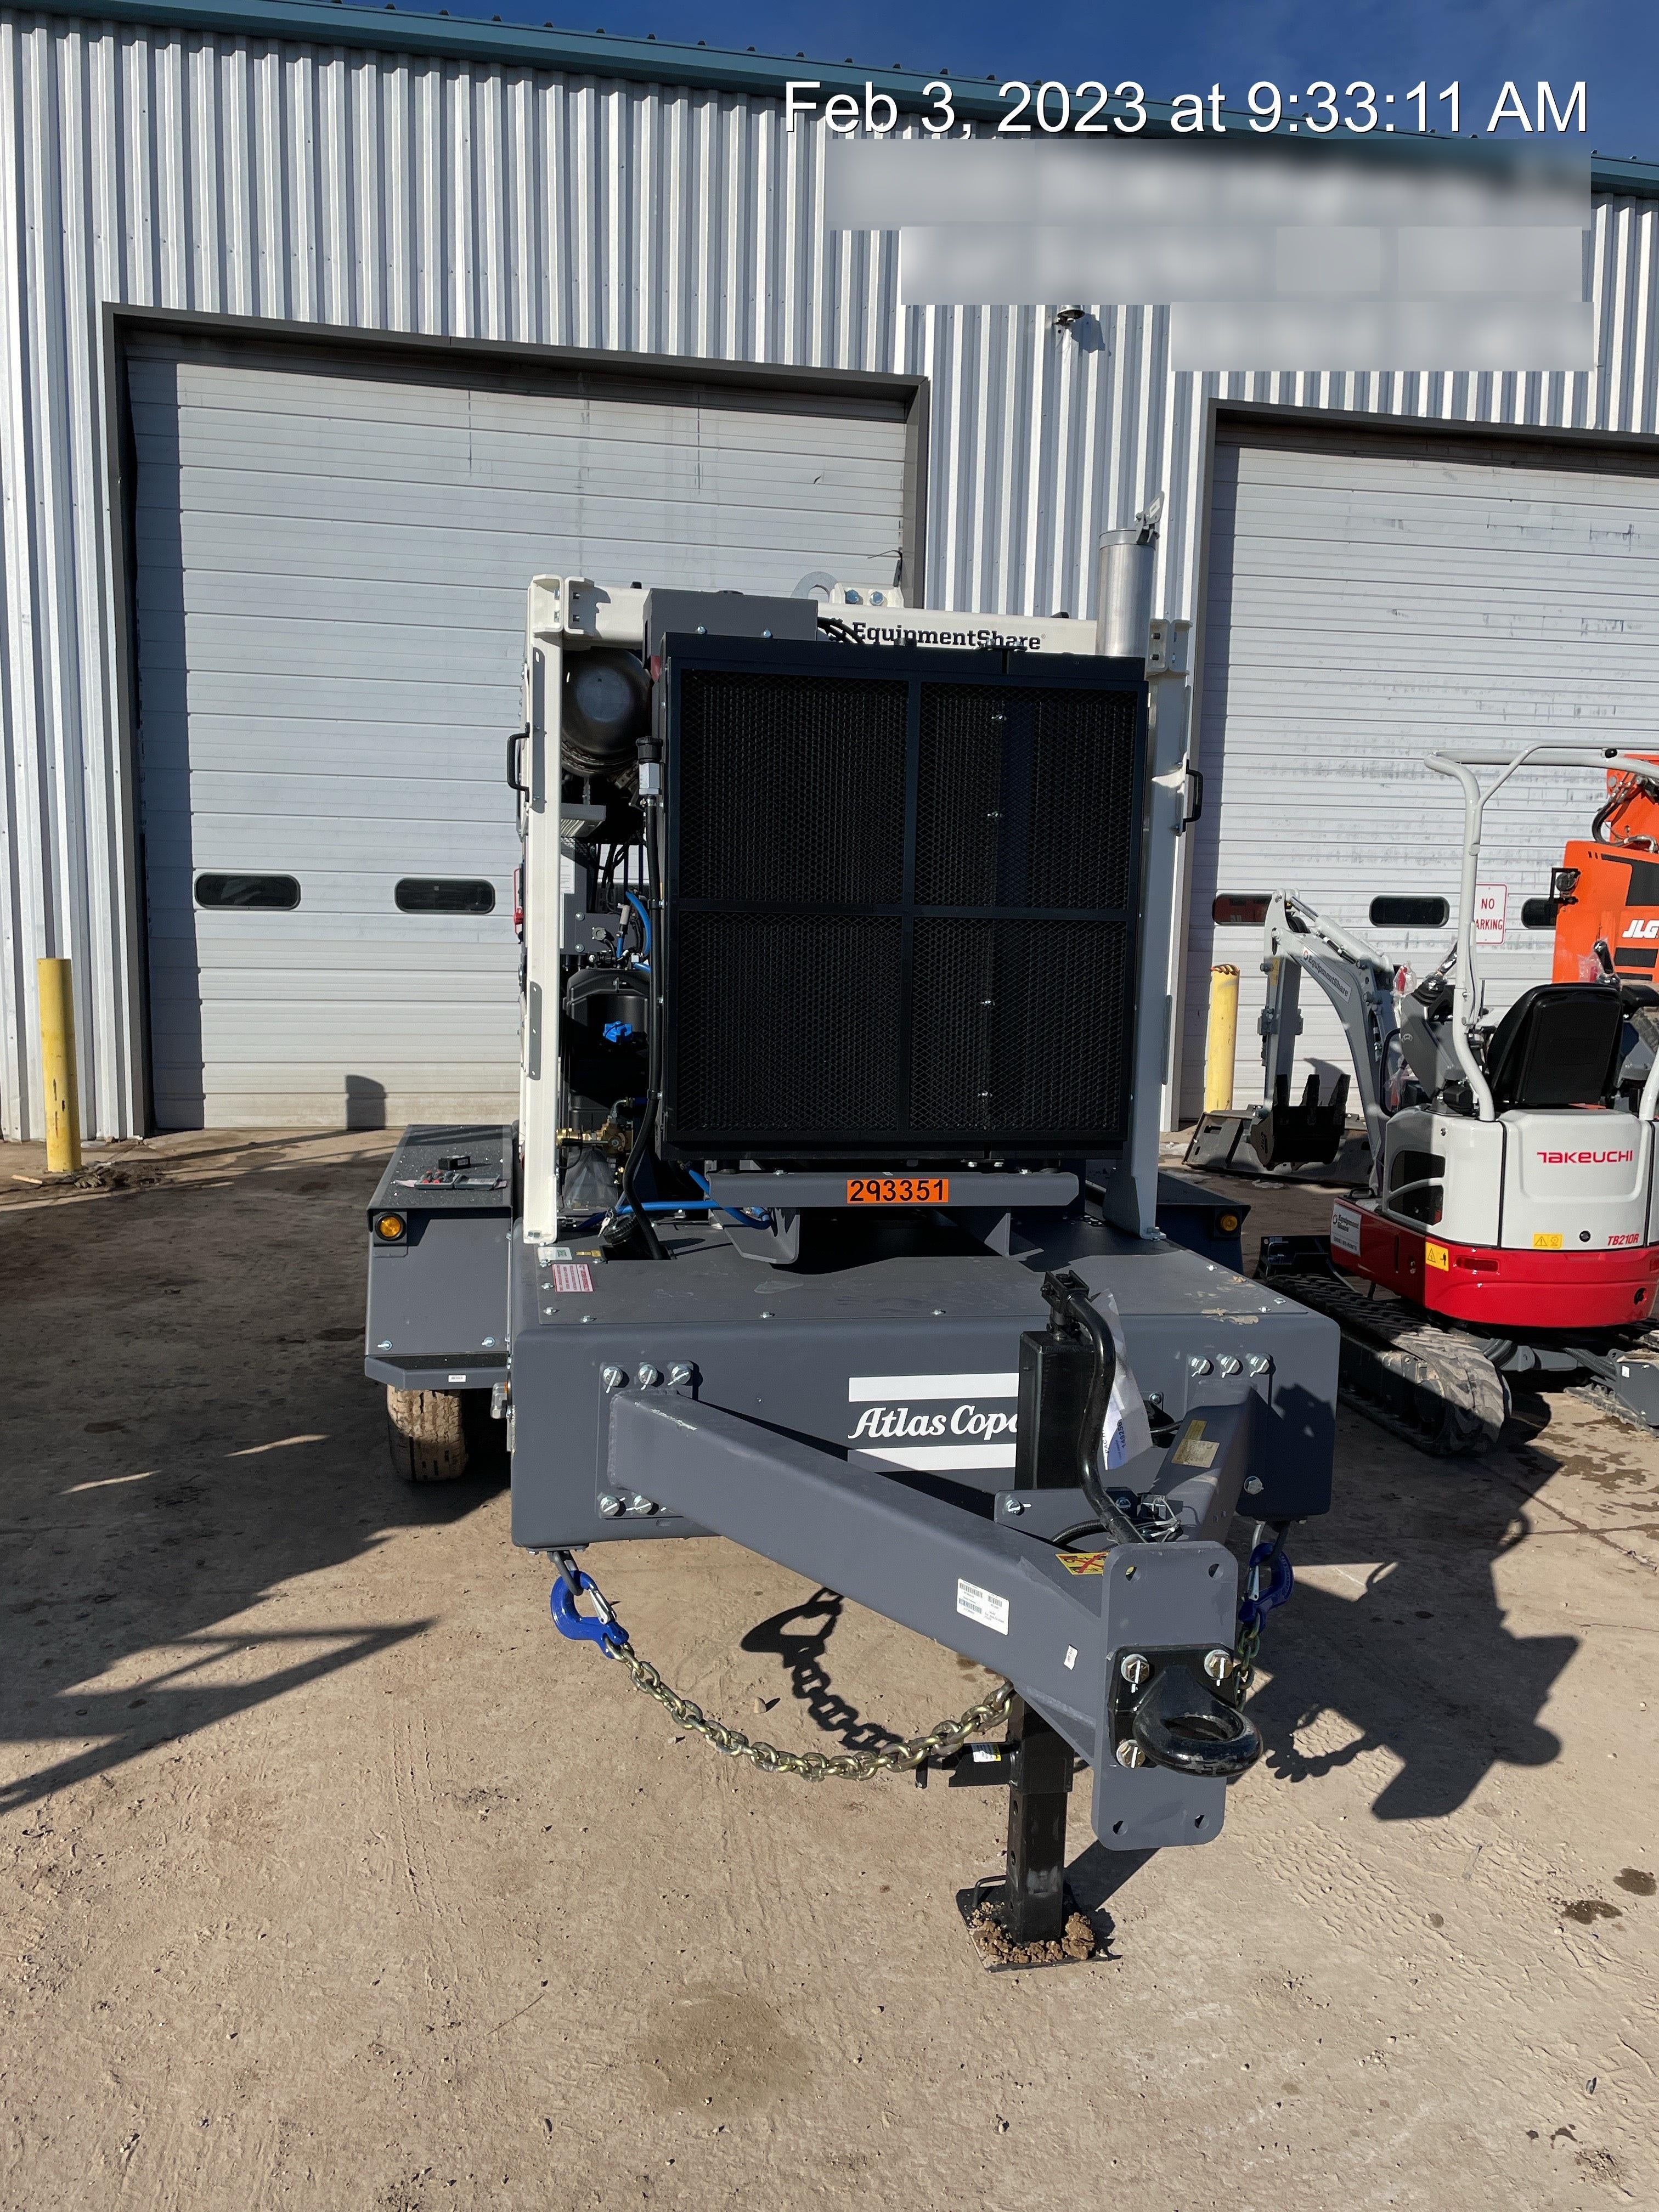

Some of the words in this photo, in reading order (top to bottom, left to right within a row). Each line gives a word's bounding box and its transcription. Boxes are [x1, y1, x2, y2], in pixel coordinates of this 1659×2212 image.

[1481, 898, 1494, 910] NO
[1476, 919, 1503, 930] ARKING
[1622, 919, 1659, 939] JLG
[1308, 955, 1348, 997] EquipmentShare
[849, 1180, 943, 1202] 293351
[1607, 1233, 1640, 1246] TB210R
[848, 1407, 947, 1439] Atlas
